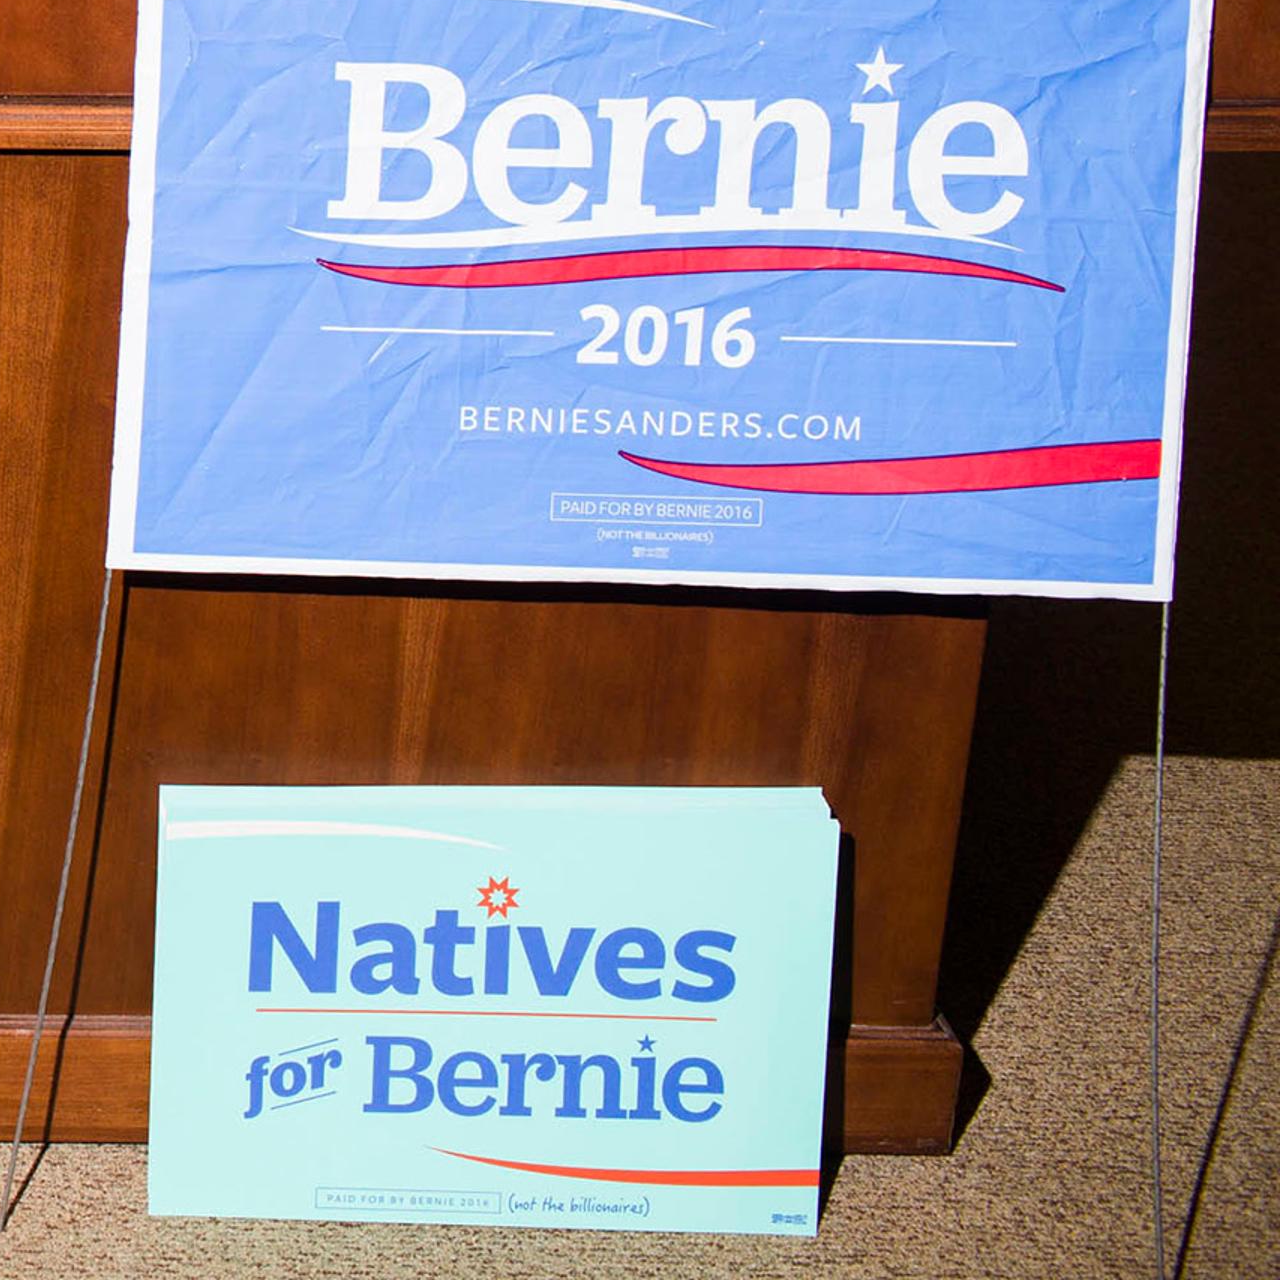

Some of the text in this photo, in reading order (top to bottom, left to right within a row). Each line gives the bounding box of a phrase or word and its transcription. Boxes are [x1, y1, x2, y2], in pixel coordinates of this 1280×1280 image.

[326, 47, 1030, 236] Bernie
[576, 304, 757, 370] 2016
[458, 405, 863, 442] BERNIESANDERS.COM
[560, 500, 754, 520] PAID FOR BY BERNIE 2016
[248, 877, 737, 1003] Natives
[243, 1034, 725, 1123] for Bernie
[326, 1192, 651, 1218] PAID FOR BY BERNIE 2016 (not the billionaires)
